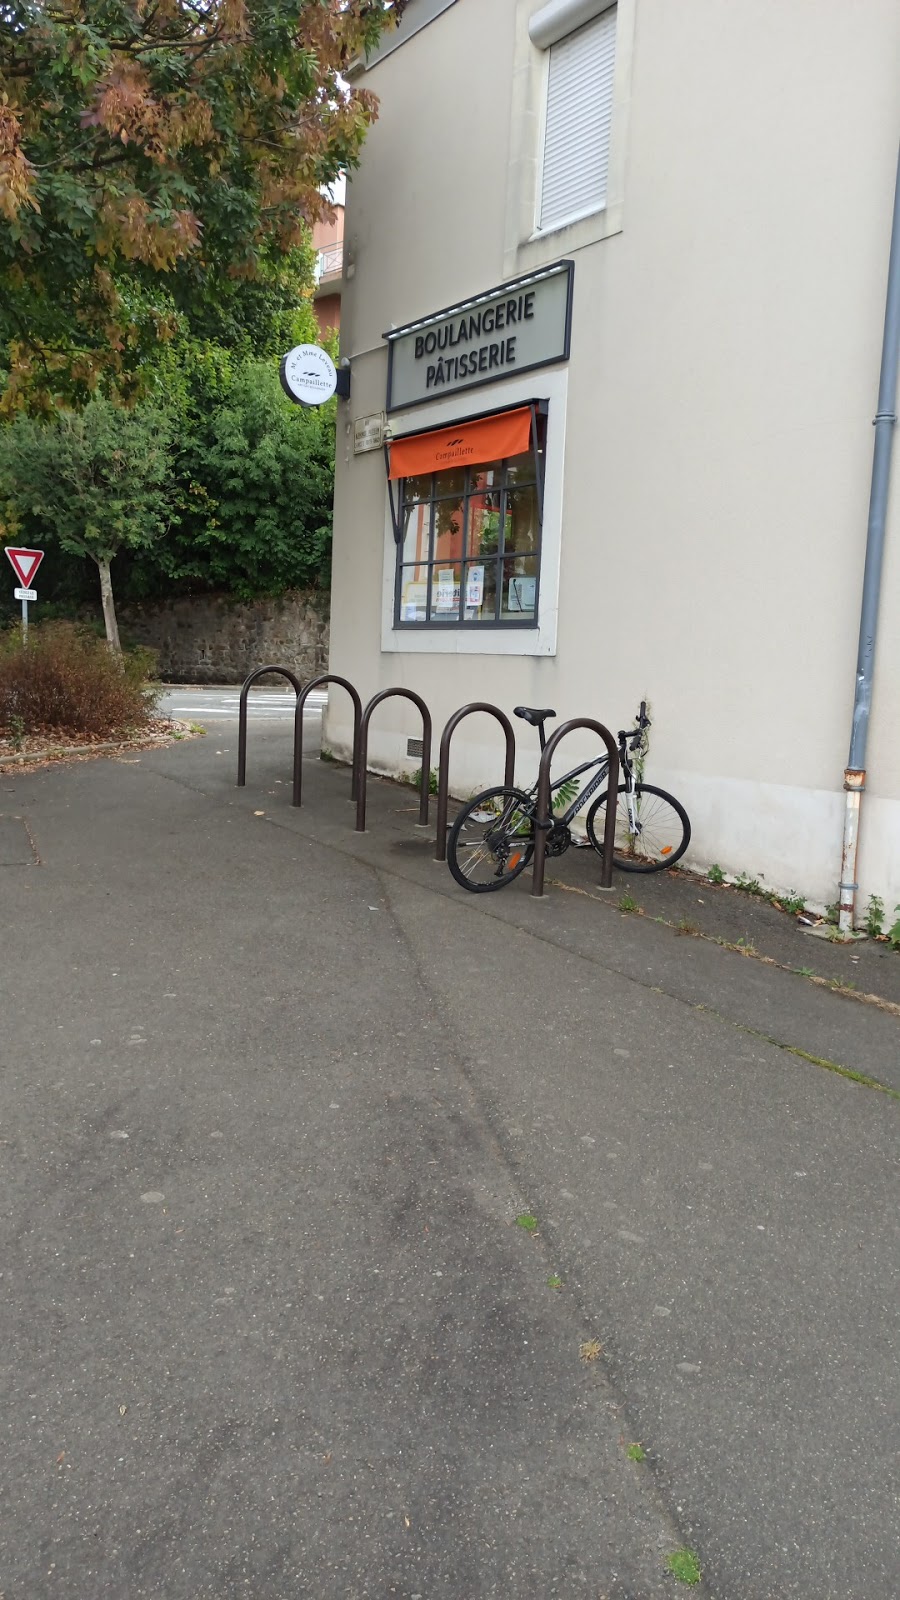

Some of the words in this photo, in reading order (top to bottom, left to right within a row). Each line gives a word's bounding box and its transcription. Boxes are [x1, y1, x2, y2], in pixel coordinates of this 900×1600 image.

[414, 291, 535, 359] BOULANGERIE
[291, 375, 333, 388] Campaillette
[426, 336, 517, 388] PÂTISSERIE
[435, 447, 474, 460] Campaillette
[573, 769, 608, 816] ROCKRIDER
